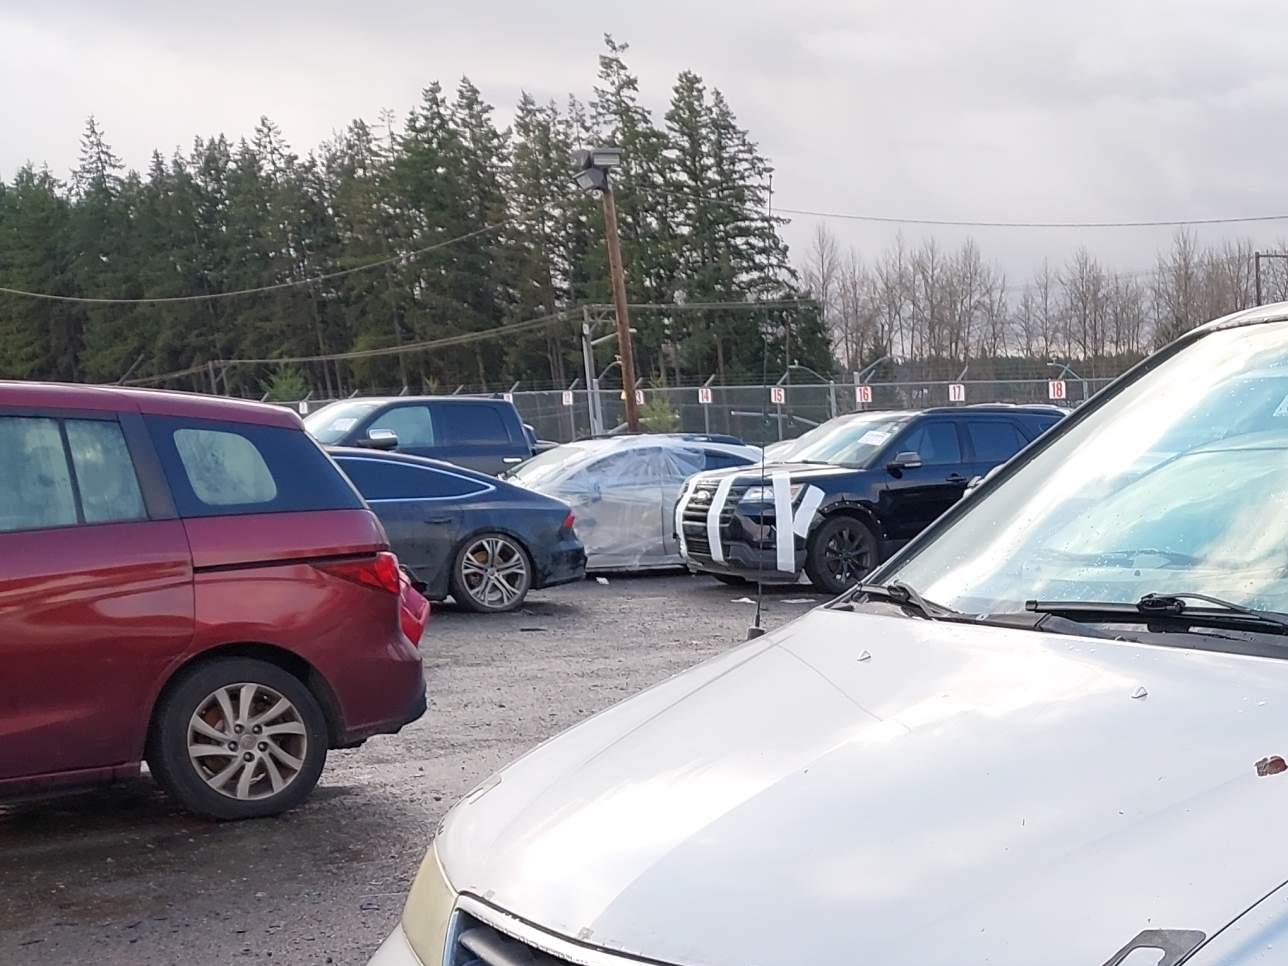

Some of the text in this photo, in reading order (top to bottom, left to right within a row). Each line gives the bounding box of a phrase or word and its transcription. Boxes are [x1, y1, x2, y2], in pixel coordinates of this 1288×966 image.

[700, 389, 710, 402] 14
[773, 389, 784, 403] 15
[859, 387, 869, 401] 16
[951, 386, 961, 401] 17
[1051, 382, 1063, 398] 18
